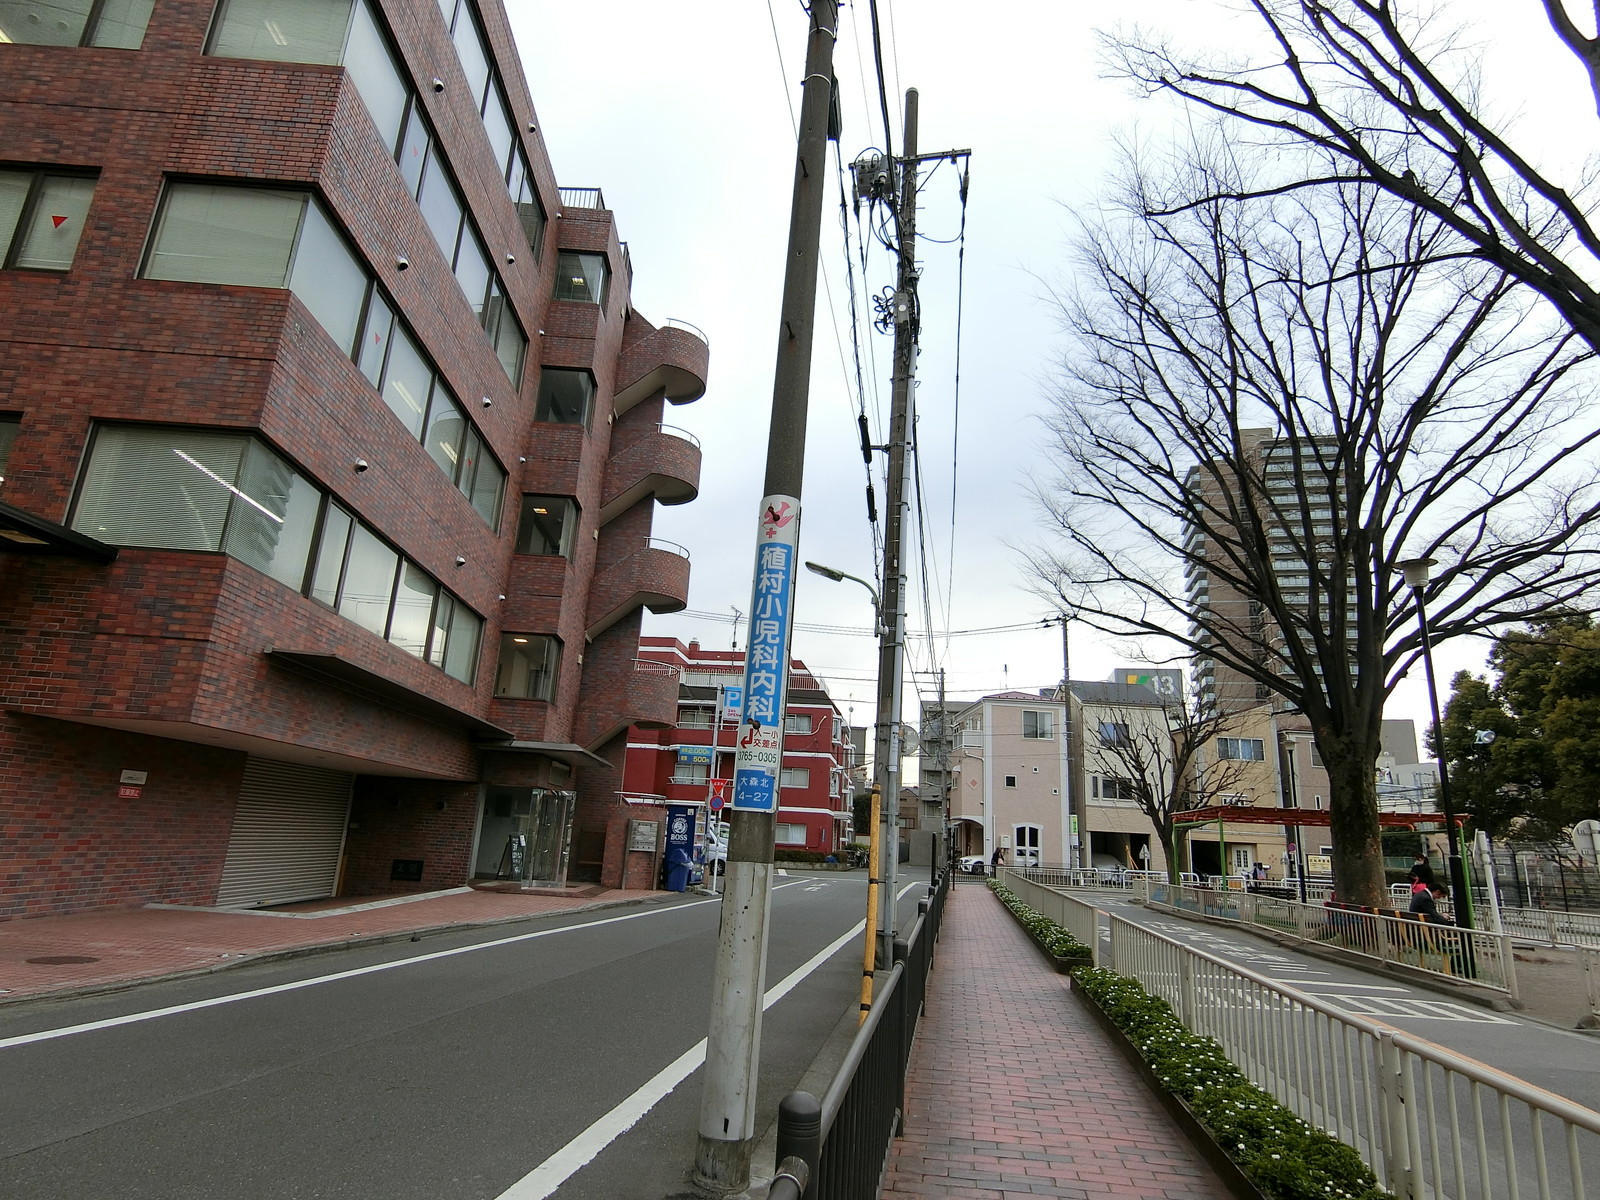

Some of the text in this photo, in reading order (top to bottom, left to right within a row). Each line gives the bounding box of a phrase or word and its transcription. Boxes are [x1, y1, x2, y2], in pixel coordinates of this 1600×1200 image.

[747, 546, 788, 722] 植村小児科内科
[1151, 675, 1175, 695] 13
[726, 691, 740, 707] P
[753, 738, 778, 749] 交差点
[737, 750, 777, 763] 3765-0305
[740, 776, 769, 787] 大森北
[738, 791, 769, 802] 4-27
[670, 833, 688, 841] BOSS
